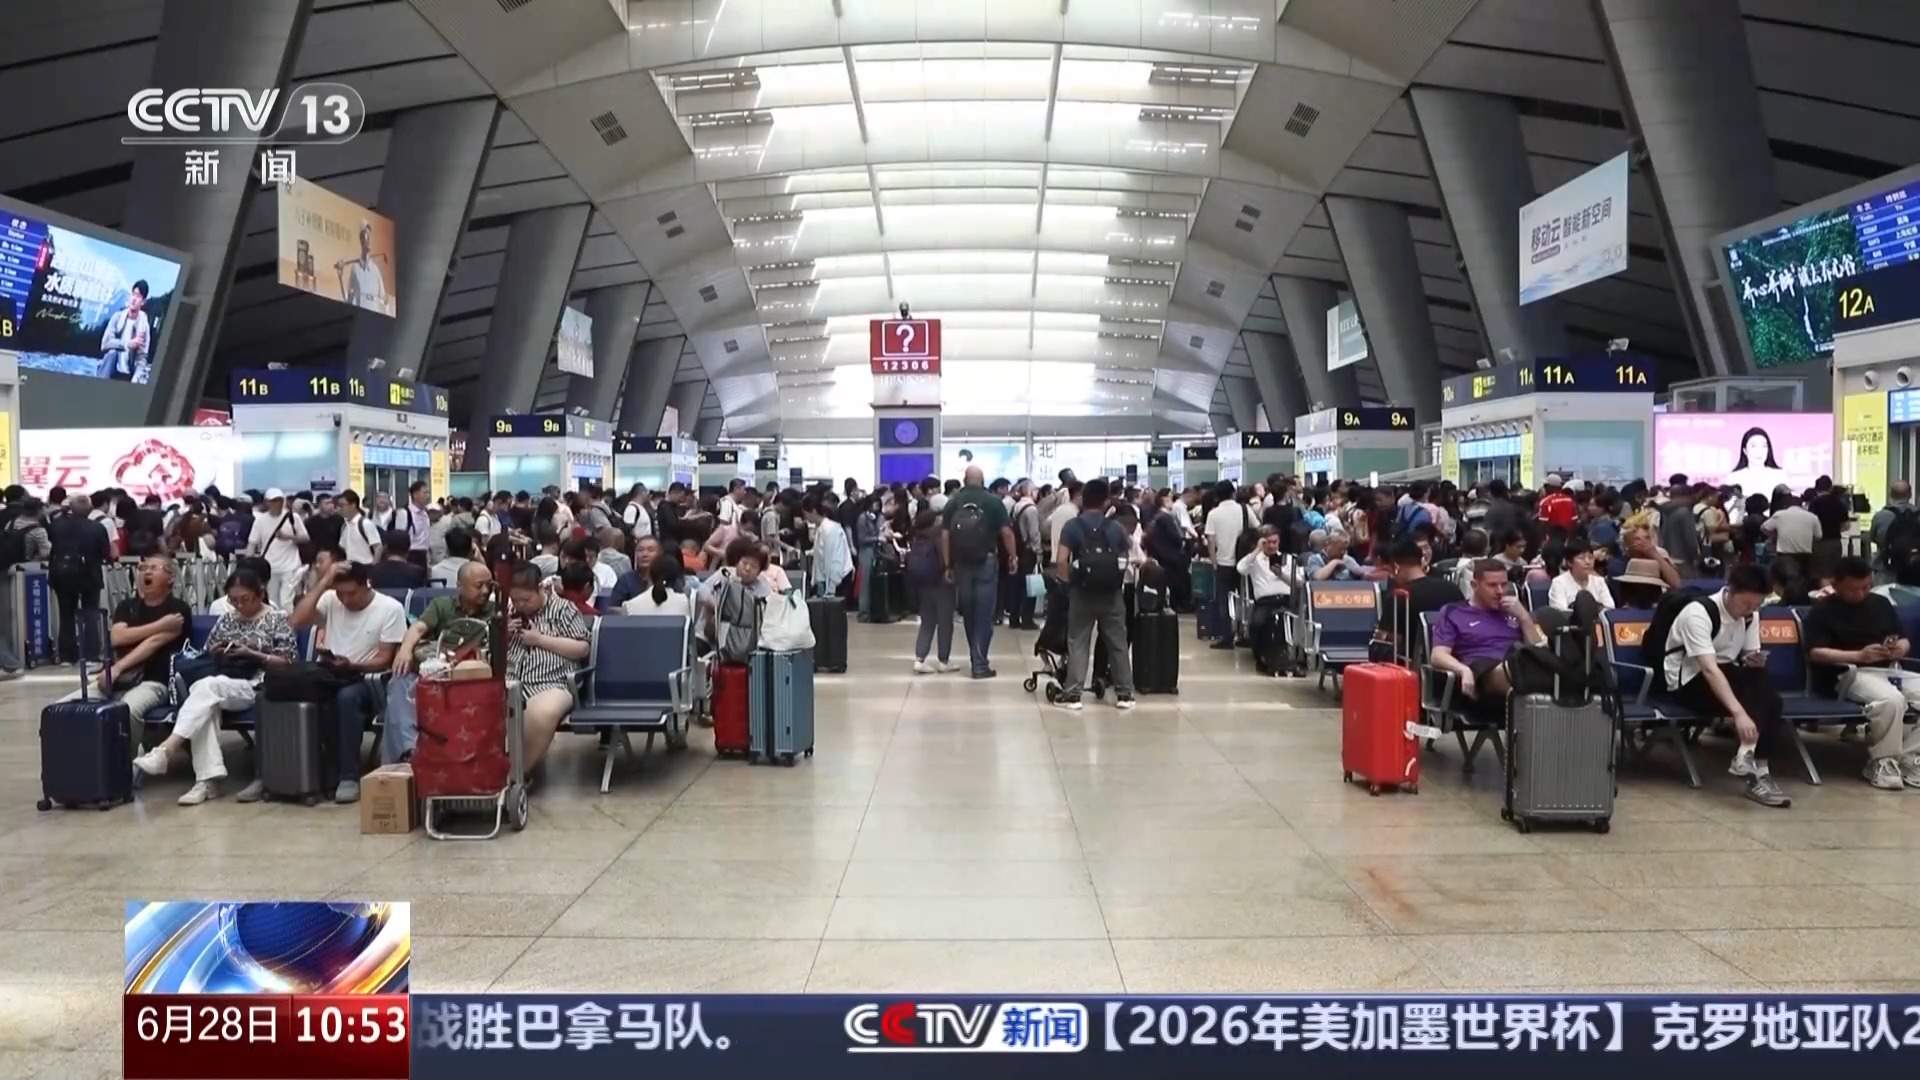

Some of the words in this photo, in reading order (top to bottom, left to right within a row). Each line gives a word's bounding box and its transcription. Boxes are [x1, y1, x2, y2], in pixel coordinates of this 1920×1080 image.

[1531, 216, 1561, 251] 移动云
[1563, 196, 1612, 238] 智能新空间
[1839, 288, 1875, 319] 12A
[882, 361, 929, 371] 12306
[1543, 365, 1575, 384] 11A
[1616, 365, 1647, 384] 11A
[1519, 367, 1533, 386] 11A
[239, 378, 268, 395] 11B
[309, 377, 340, 395] 11B
[349, 378, 364, 397] 11B
[496, 420, 512, 433] 9B
[544, 420, 560, 433] 9B
[1343, 413, 1360, 426] 9A
[1391, 413, 1408, 426] 9A
[620, 440, 632, 450] 7B
[655, 440, 667, 450] 7B
[1247, 435, 1260, 446] 7A
[1282, 435, 1295, 446] 7A
